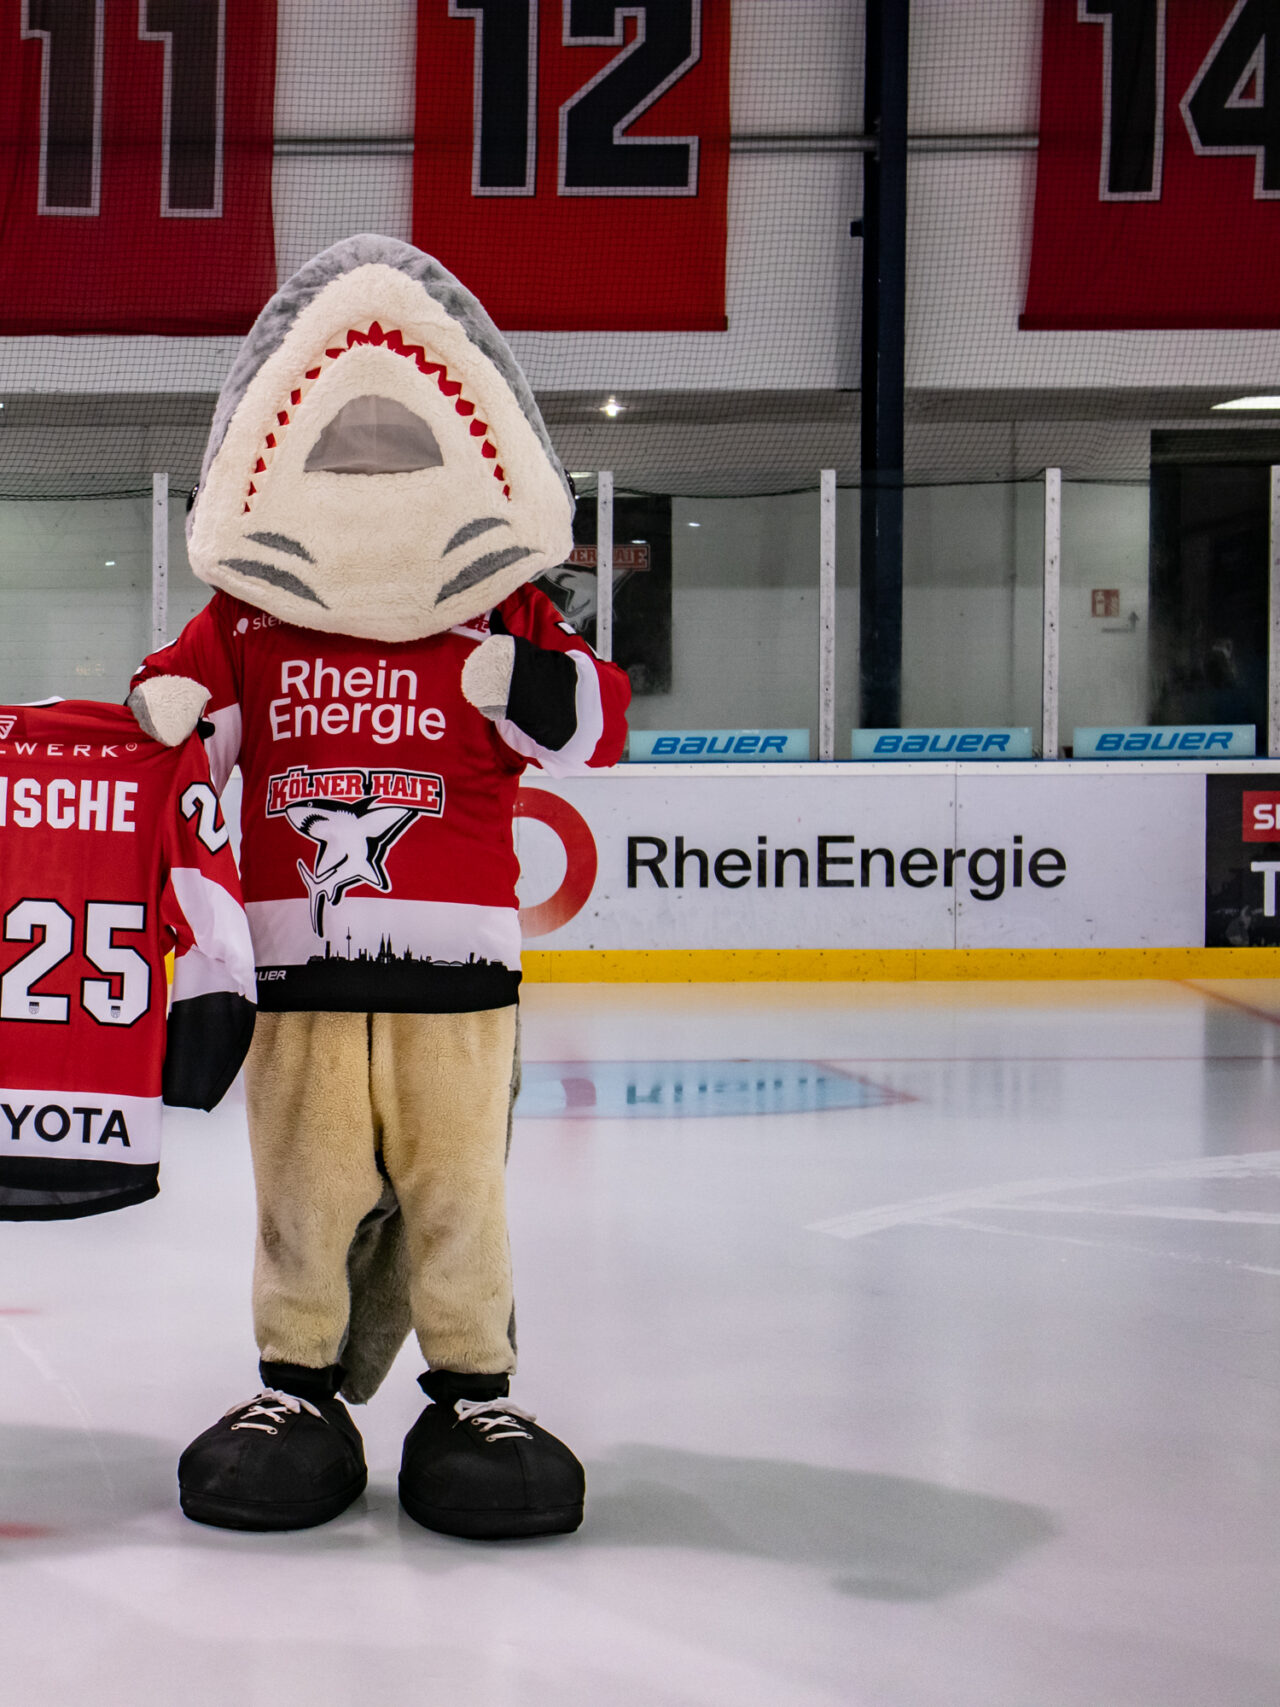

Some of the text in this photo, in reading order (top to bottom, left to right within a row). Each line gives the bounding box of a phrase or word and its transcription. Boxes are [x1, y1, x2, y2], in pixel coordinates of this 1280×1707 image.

[20, 0, 225, 217] 11
[448, 0, 700, 197] 12
[1077, 0, 1280, 201] 14
[281, 658, 418, 700] Rhein
[269, 697, 447, 745] Energie
[1095, 732, 1234, 751] BAUER
[651, 736, 788, 755] BAUER
[873, 734, 1011, 753] BAUER
[269, 771, 440, 812] KÖLNER HAIE
[1253, 804, 1280, 830] S
[626, 835, 1067, 900] RheinEnergie
